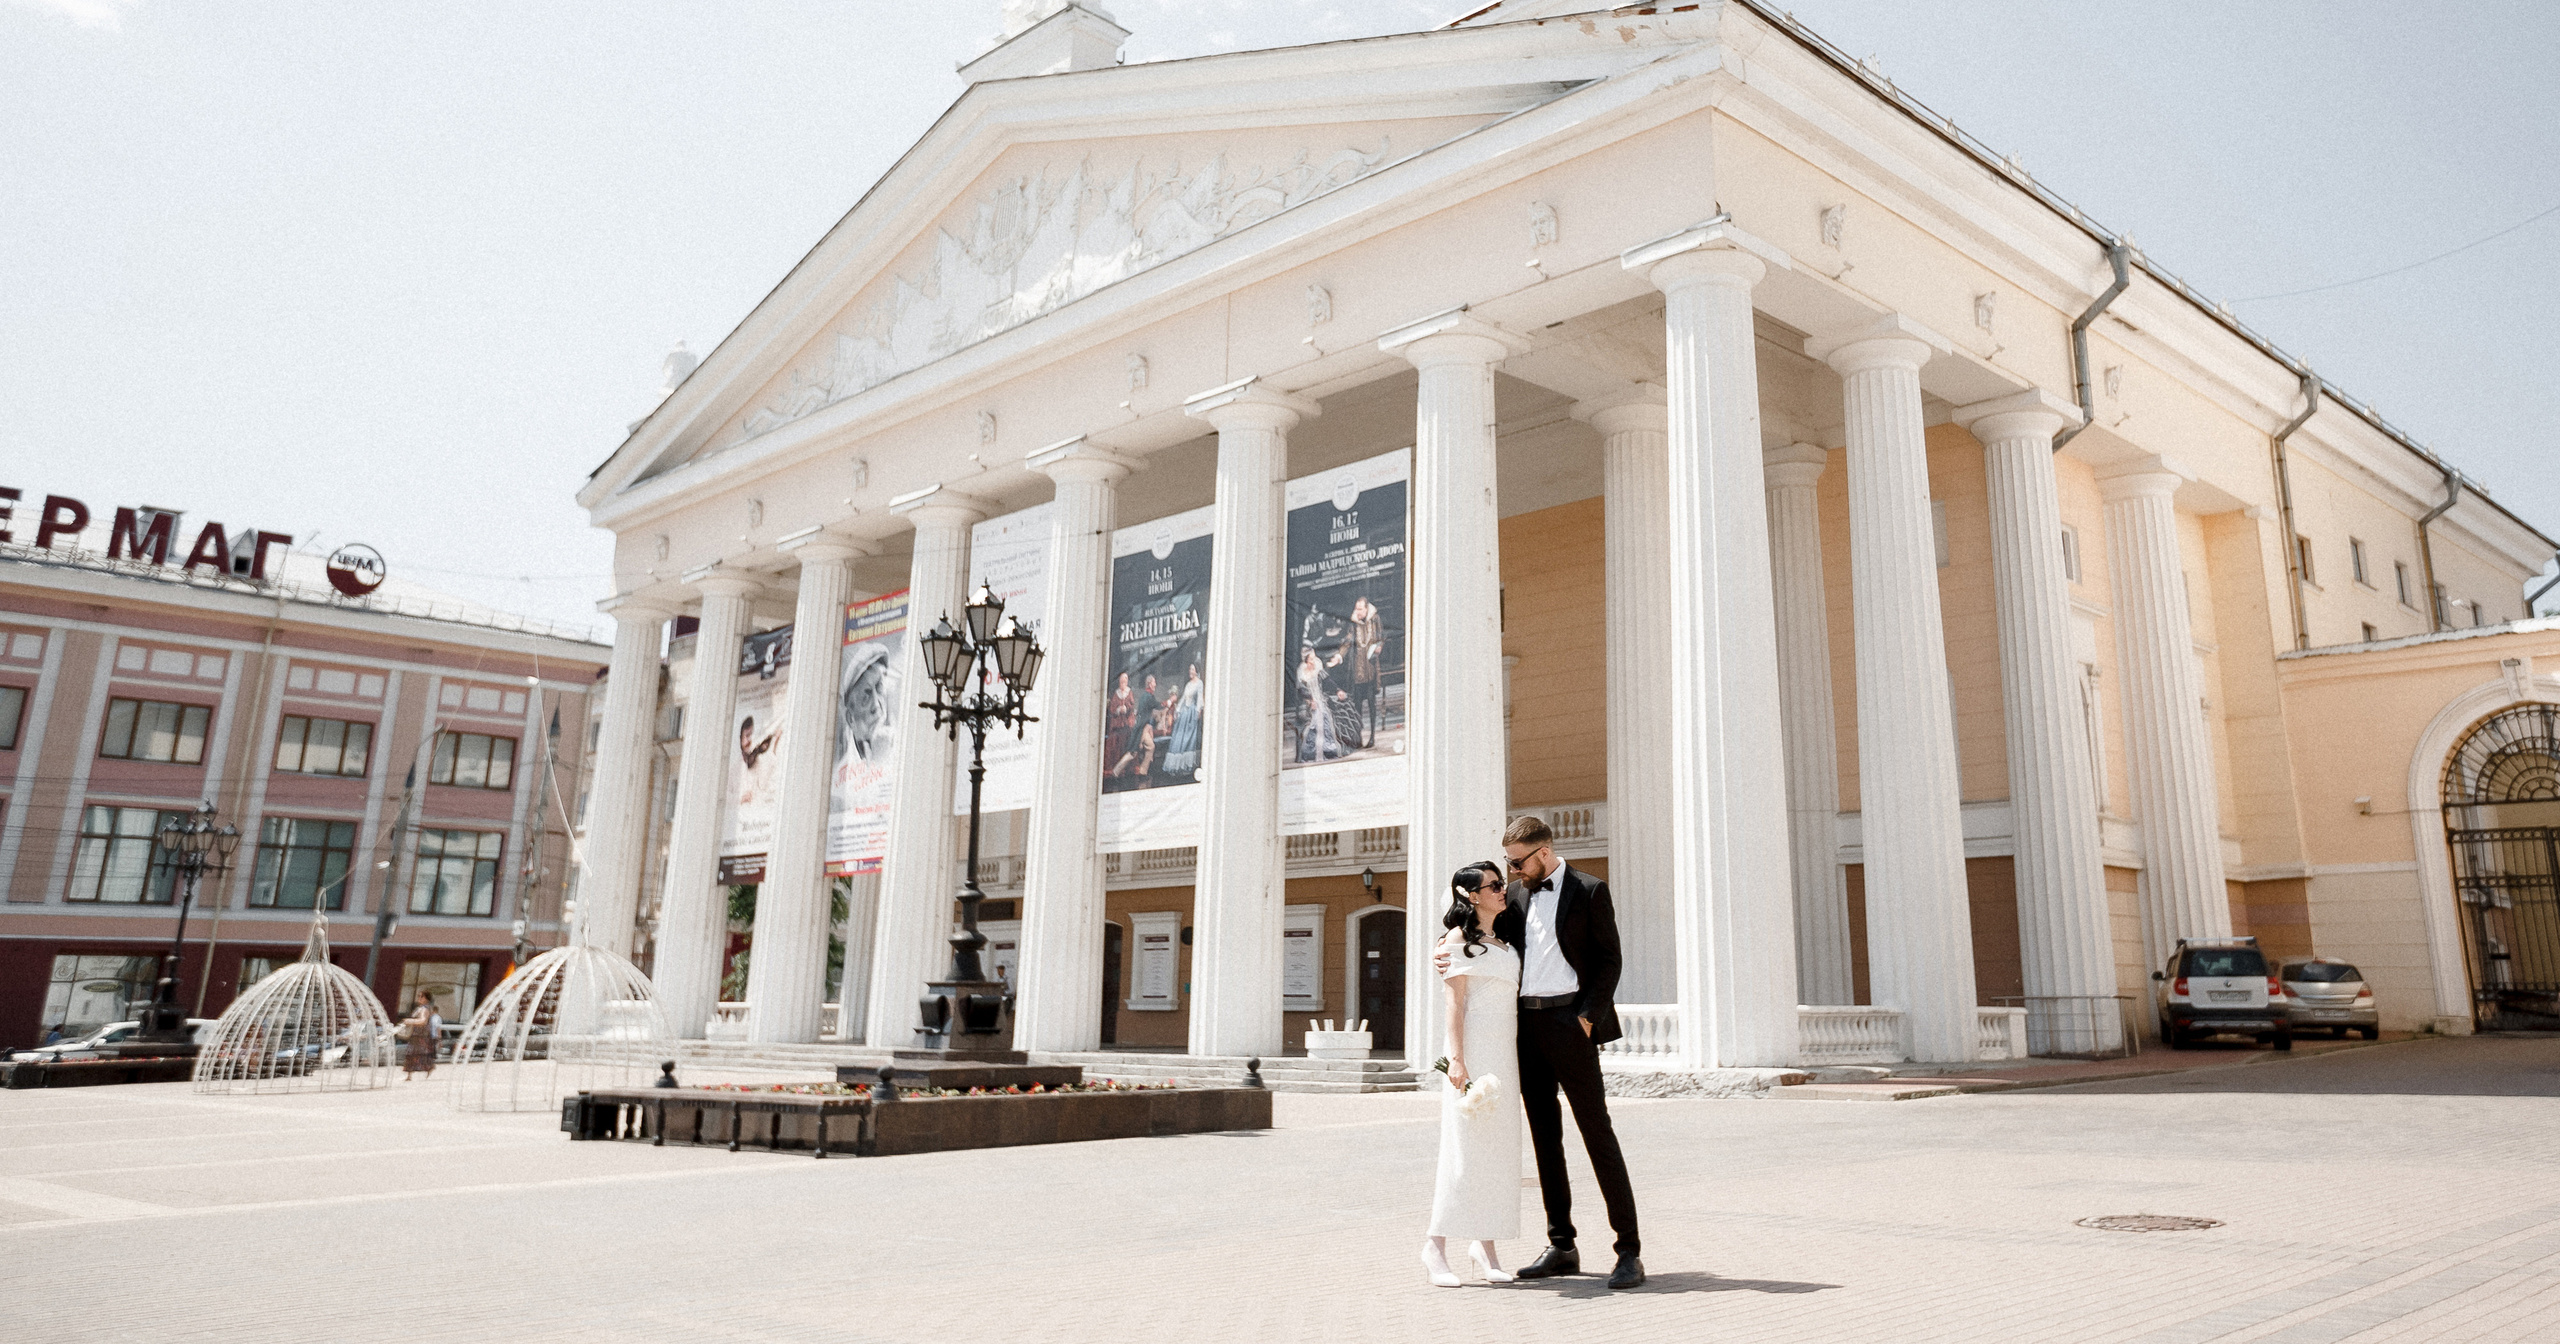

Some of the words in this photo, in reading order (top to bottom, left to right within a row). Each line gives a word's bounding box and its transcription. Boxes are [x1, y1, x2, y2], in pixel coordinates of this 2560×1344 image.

[1346, 511, 1359, 526] 17
[1329, 526, 1360, 544] ИЮНЯ
[1289, 560, 1318, 578] ТАЙНЫ
[1376, 542, 1405, 560] ДВОРА
[1119, 608, 1201, 643] ЖЕНИТЬБА
